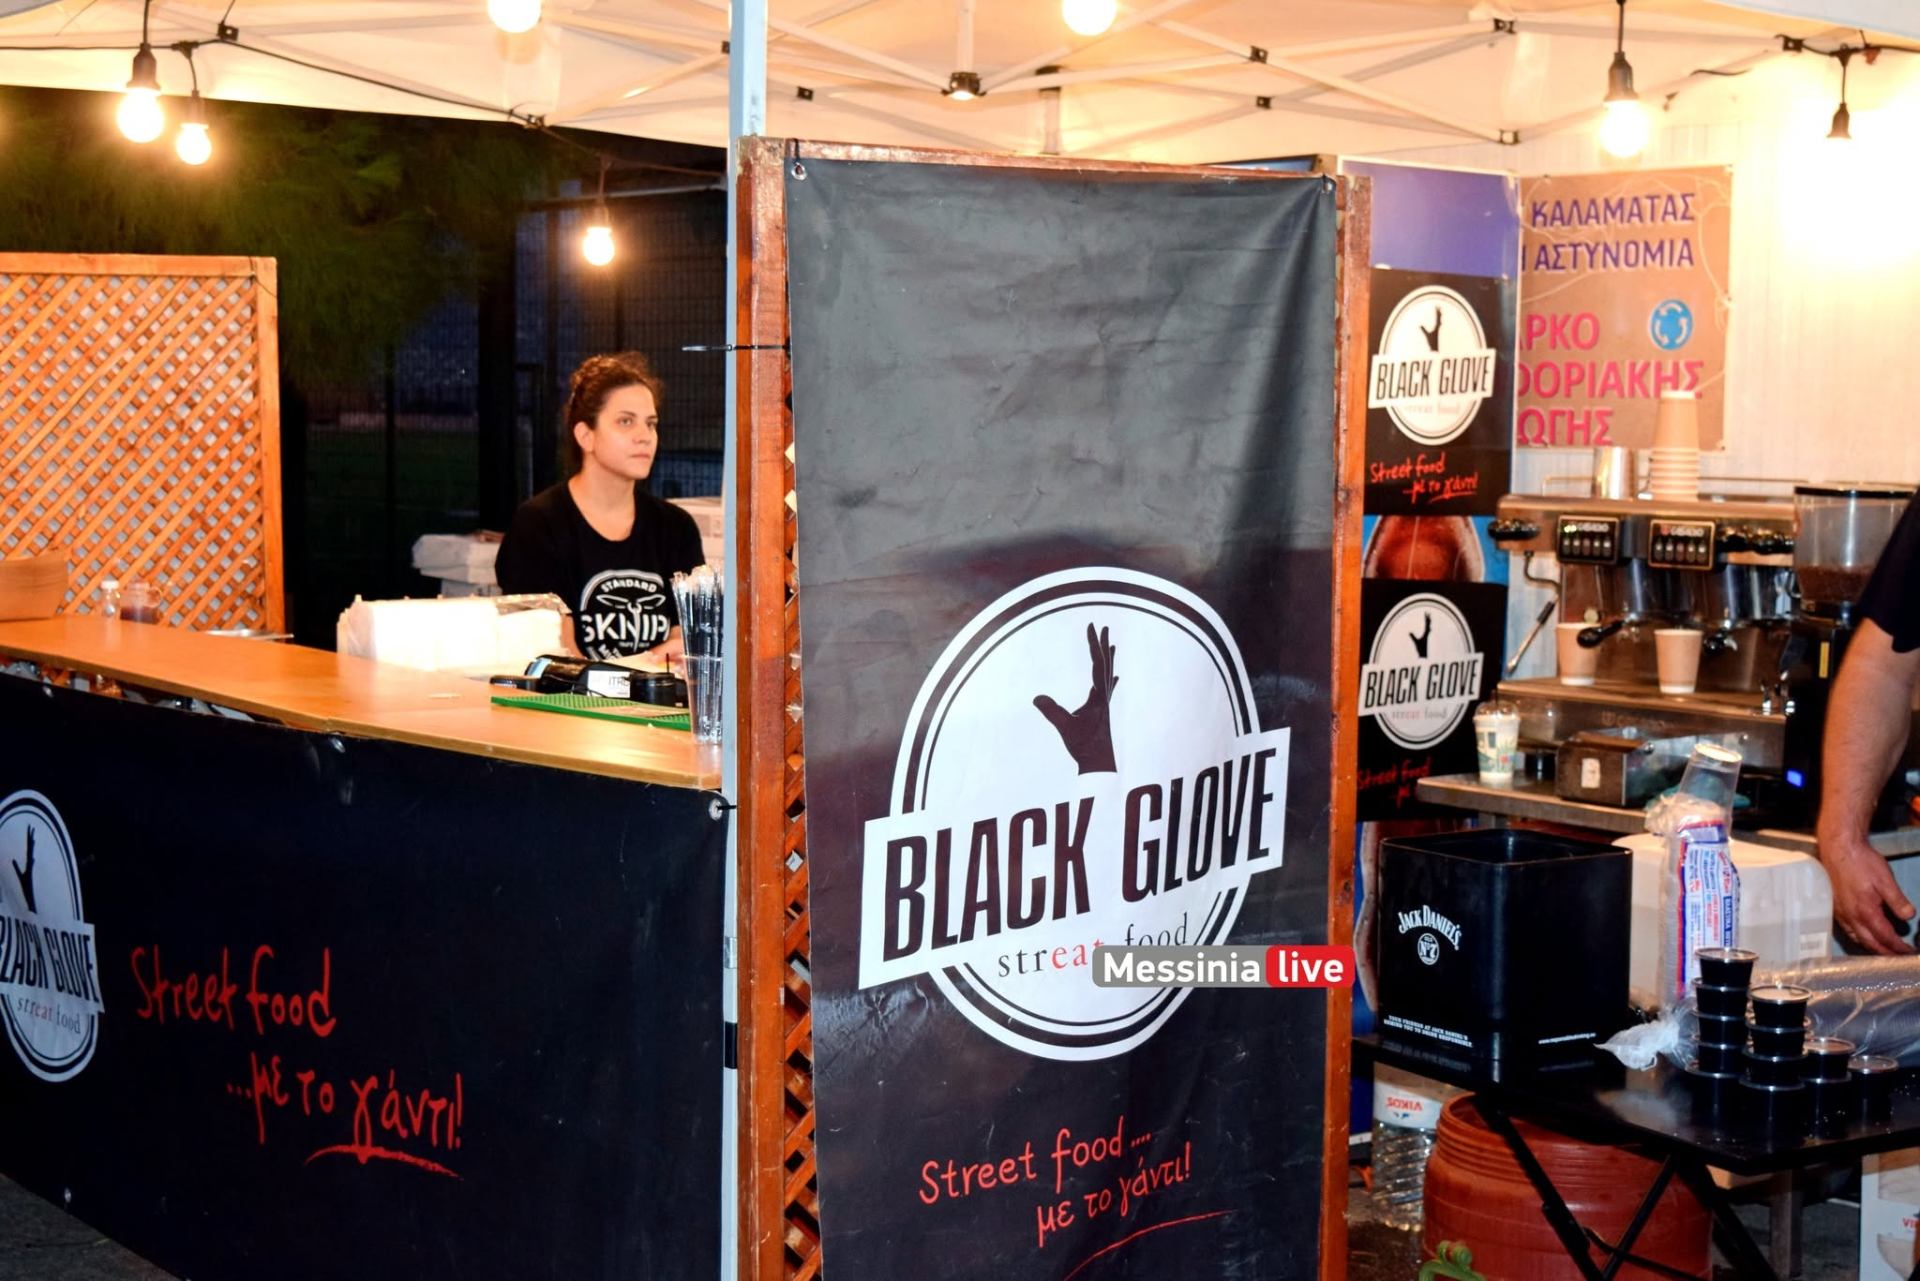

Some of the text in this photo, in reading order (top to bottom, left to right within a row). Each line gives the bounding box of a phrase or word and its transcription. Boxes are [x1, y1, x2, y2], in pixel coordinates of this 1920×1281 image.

[1531, 193, 1695, 228] ΚΑΛΑΜΑΤΑΣ
[1534, 238, 1694, 271] ΑΣΤΥΝΟΜΙΑ
[1519, 312, 1600, 351] ΡΚΟ
[1376, 355, 1490, 400] BLACK GLOVE
[601, 579, 657, 593] STANDARD
[1364, 659, 1479, 709] BLACK GLOVE
[882, 747, 1277, 963] BLACK GLOVE
[1398, 909, 1423, 934] JACK
[43, 926, 99, 1003] GLOVE
[998, 938, 1105, 978] strea
[131, 944, 336, 1037] Street food
[297, 1070, 335, 1116] το
[1386, 1096, 1422, 1112] VIKOS
[919, 1142, 1037, 1204] Street
[1037, 1141, 1191, 1248] με το γάντι!
